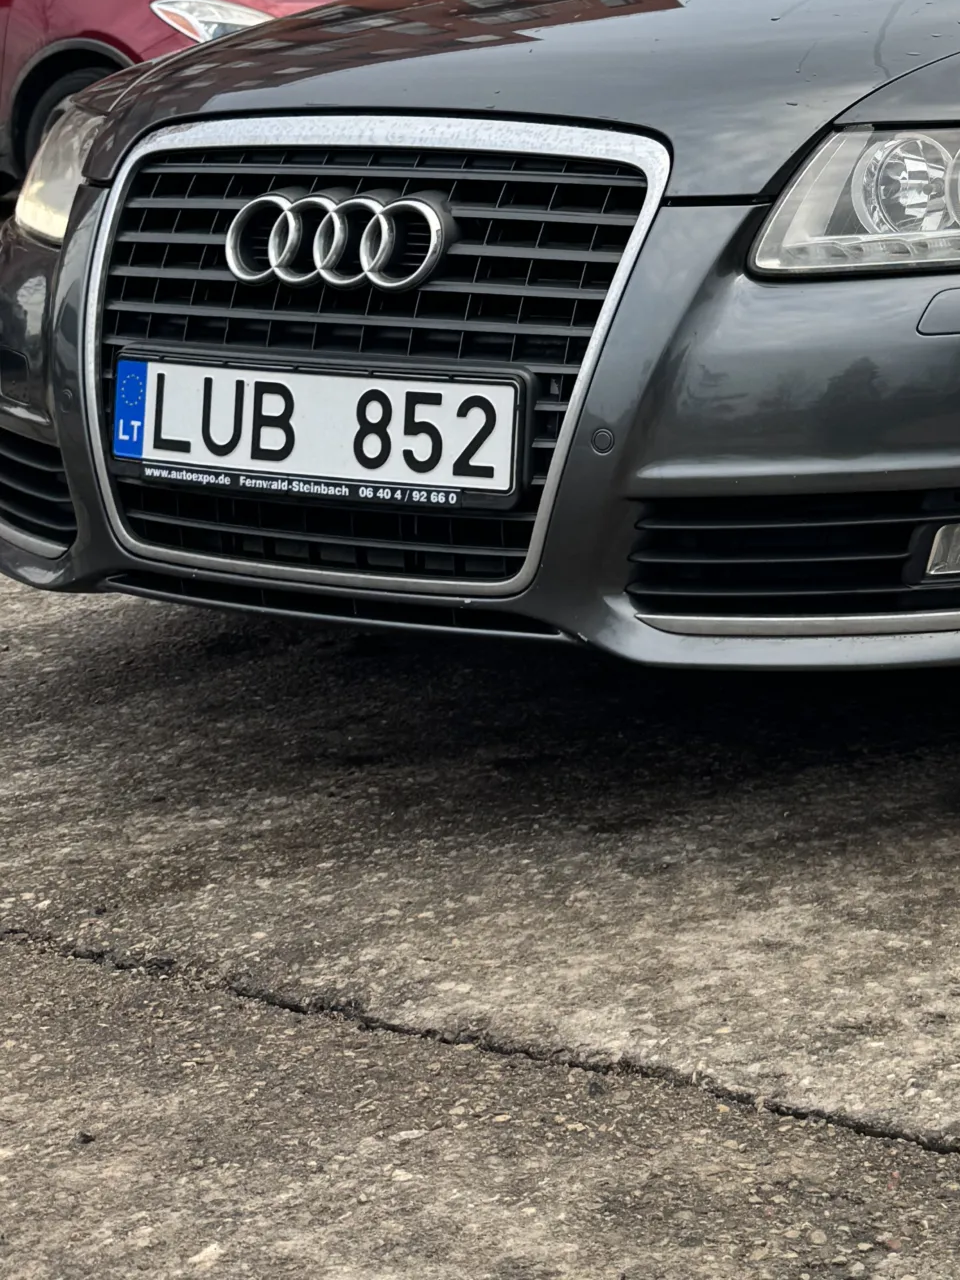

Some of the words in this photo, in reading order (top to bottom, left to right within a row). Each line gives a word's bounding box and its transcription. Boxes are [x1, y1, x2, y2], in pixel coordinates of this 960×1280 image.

[118, 418, 142, 442] LT
[152, 372, 296, 462] LUB
[352, 388, 498, 479] 852
[144, 467, 231, 485] www.autoexpo.de
[358, 486, 374, 499] 06
[376, 488, 392, 500] 40
[393, 489, 402, 501] 4
[412, 490, 428, 502] 92
[430, 491, 446, 504] 66
[448, 492, 457, 505] 0
